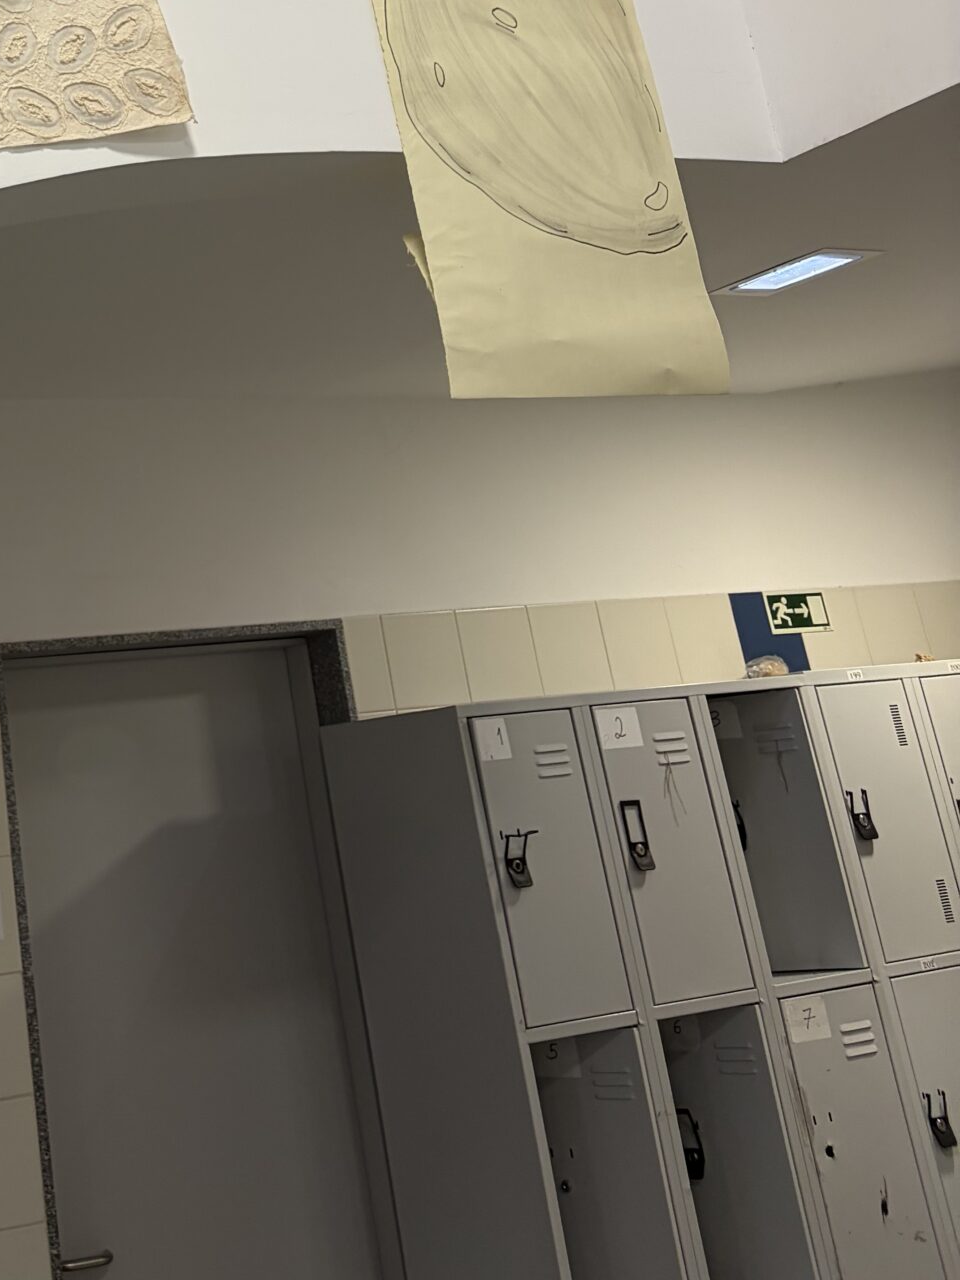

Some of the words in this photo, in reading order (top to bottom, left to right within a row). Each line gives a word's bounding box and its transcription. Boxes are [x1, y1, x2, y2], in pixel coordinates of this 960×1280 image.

[613, 716, 627, 739] 2
[673, 1019, 682, 1034] 6
[802, 1007, 816, 1030] 7
[545, 1042, 558, 1060] 5
